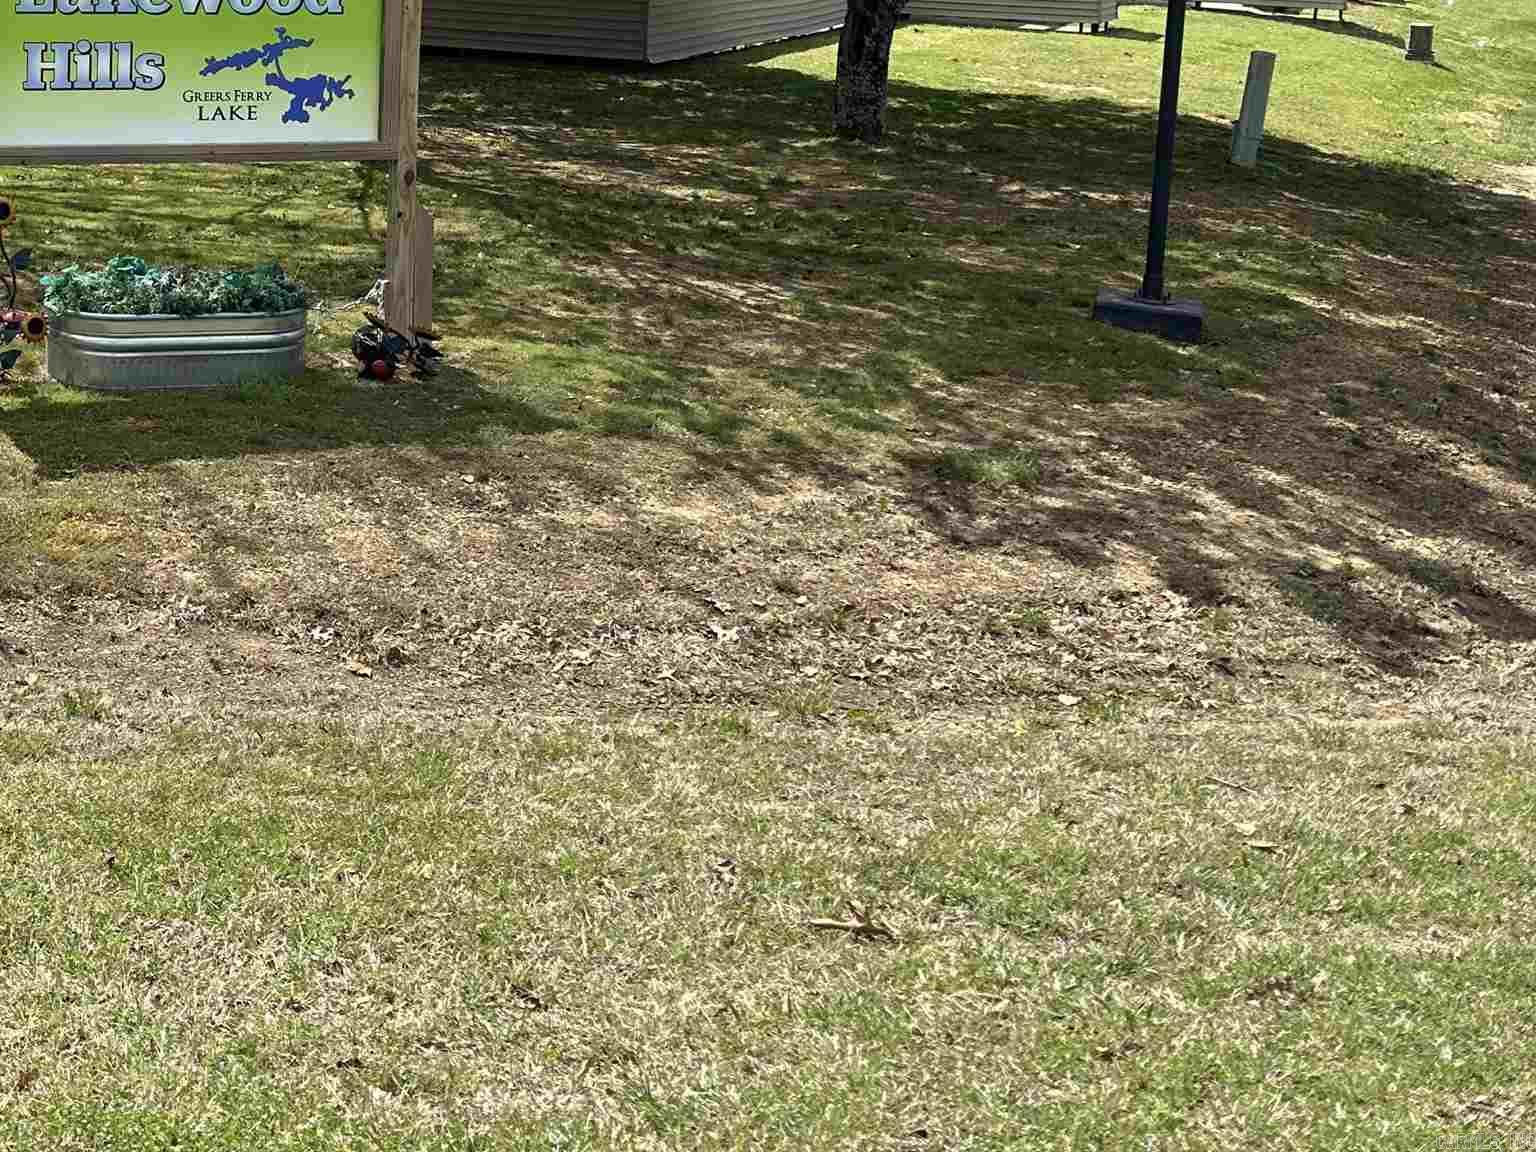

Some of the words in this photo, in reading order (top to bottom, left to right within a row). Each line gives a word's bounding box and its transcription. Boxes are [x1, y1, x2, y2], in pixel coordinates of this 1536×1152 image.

[22, 39, 166, 91] Hills
[233, 89, 273, 102] FERRY
[198, 105, 257, 121] LAKE
